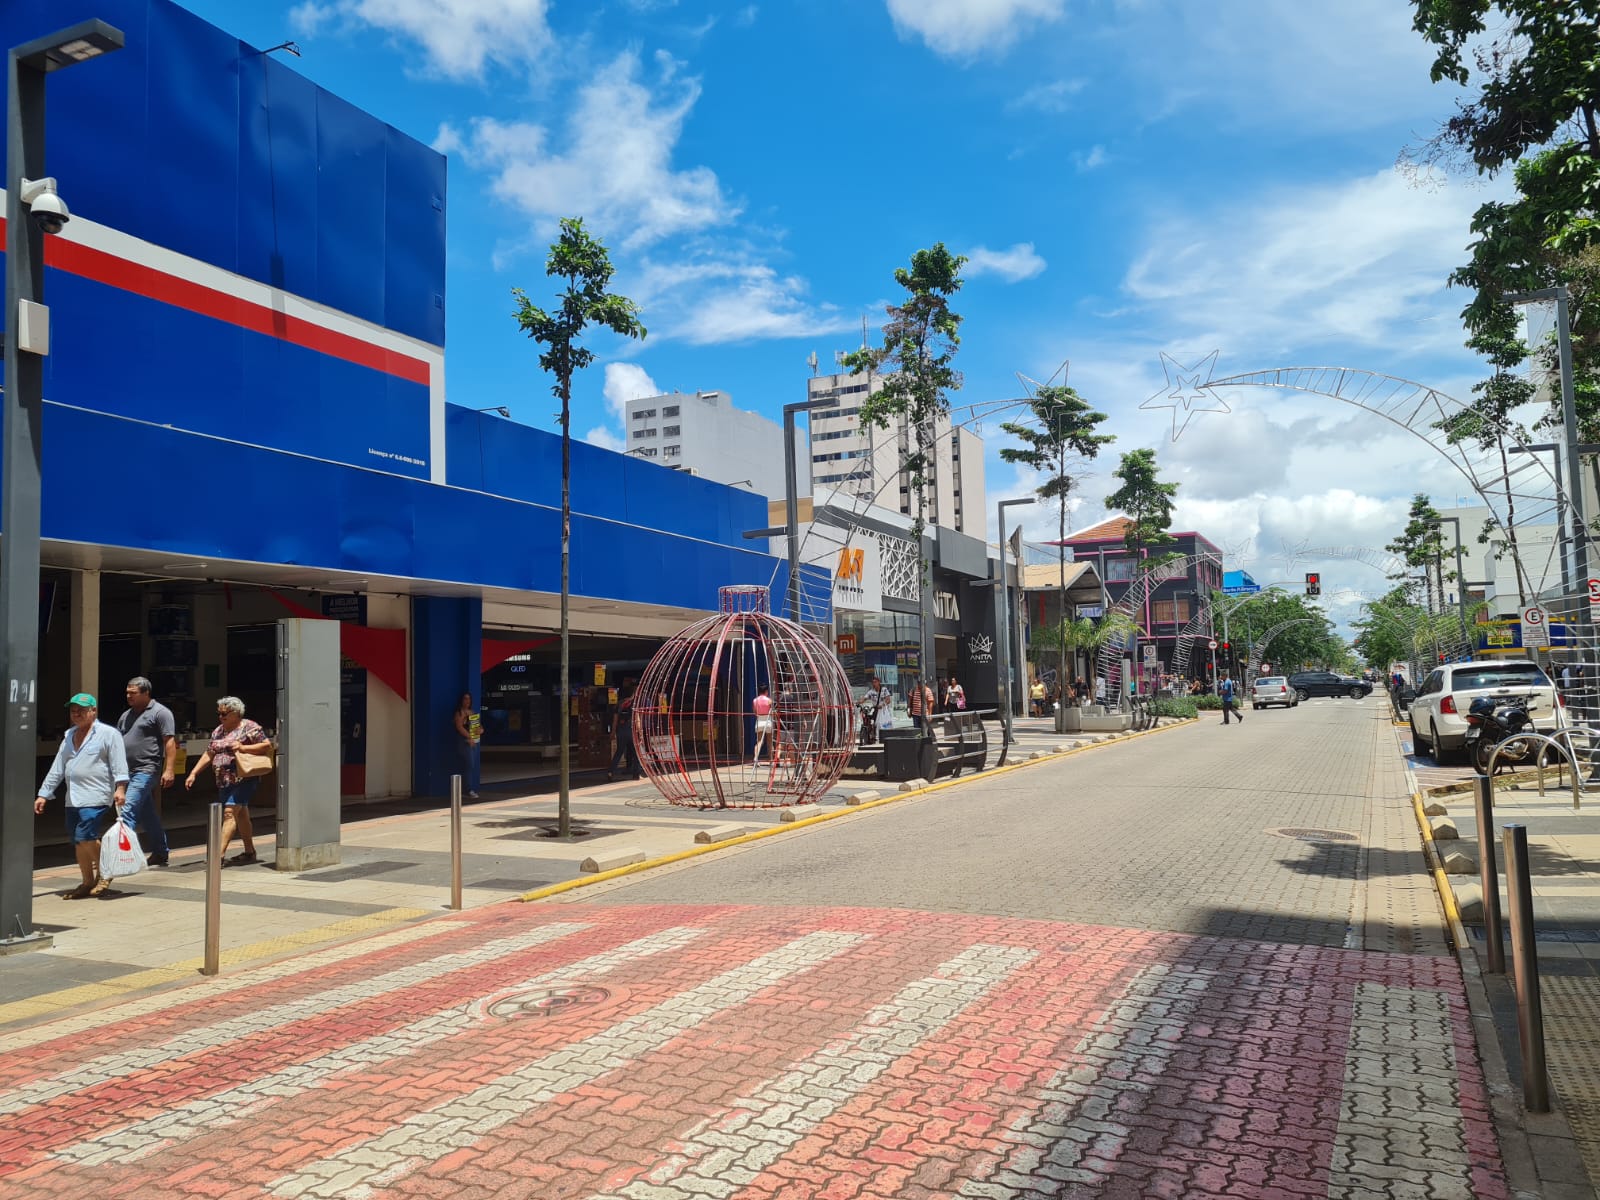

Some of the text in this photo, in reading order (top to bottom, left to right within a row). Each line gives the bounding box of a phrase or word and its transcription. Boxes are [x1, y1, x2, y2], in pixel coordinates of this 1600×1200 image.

[368, 447, 389, 459] Licença
[933, 590, 960, 621] NITA
[1531, 611, 1538, 621] E
[970, 653, 993, 661] ANITA
